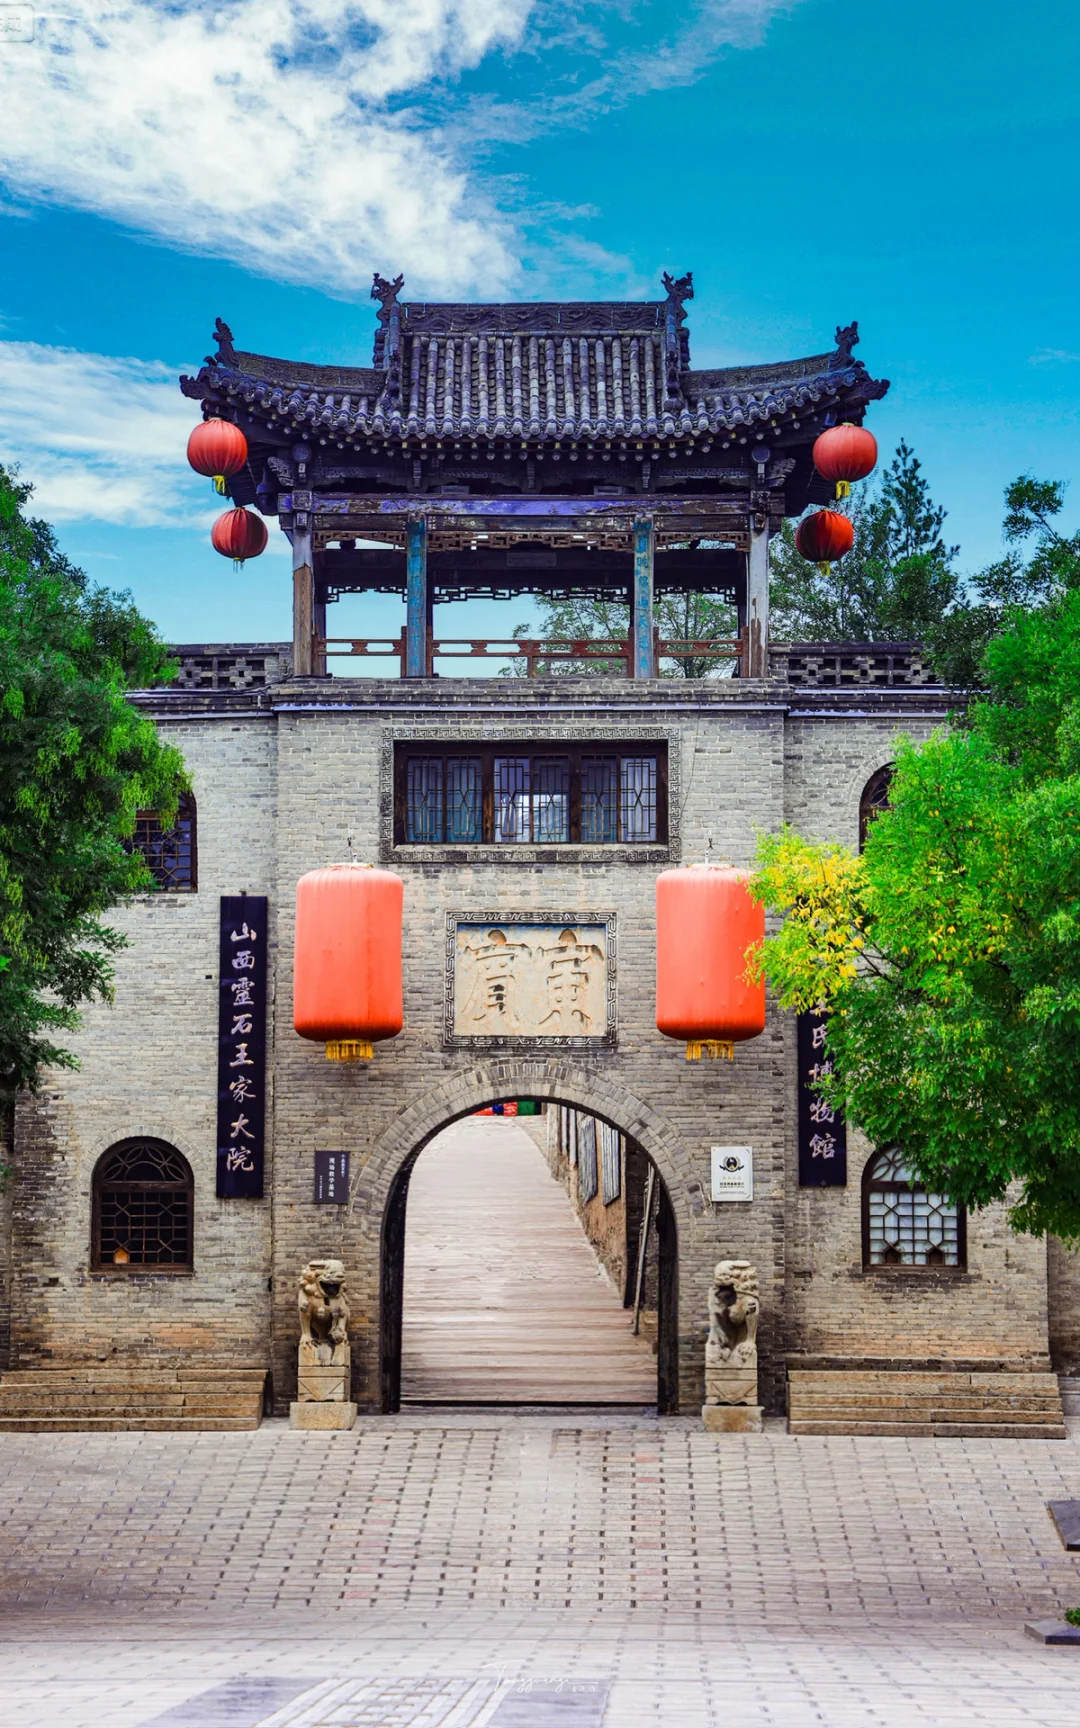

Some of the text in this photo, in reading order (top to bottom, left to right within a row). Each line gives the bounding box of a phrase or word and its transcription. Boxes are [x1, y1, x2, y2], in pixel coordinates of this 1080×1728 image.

[226, 922, 257, 1172] 山西靈石王家大院
